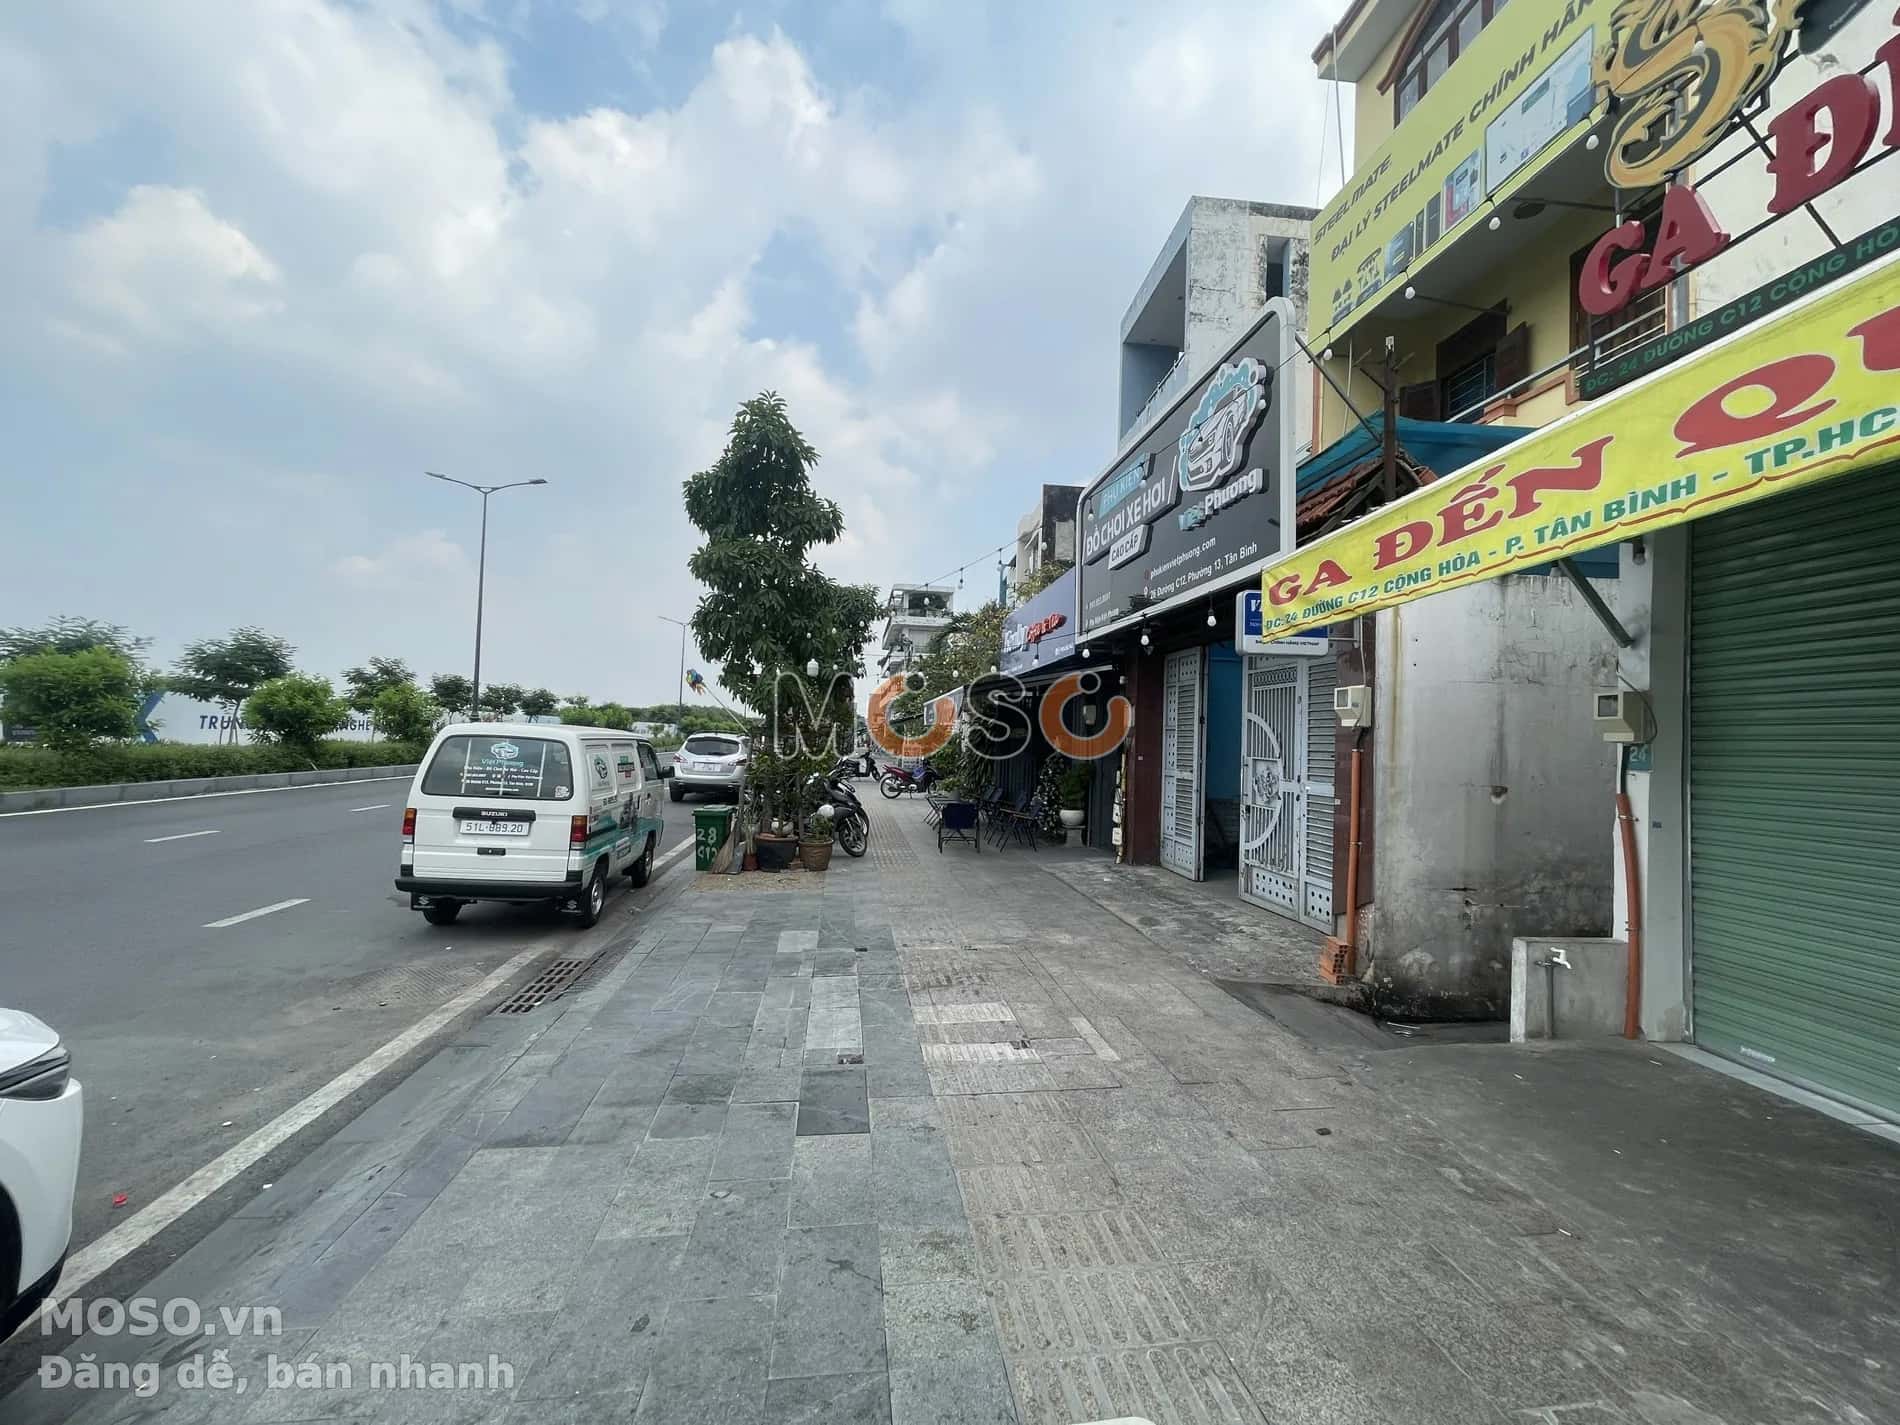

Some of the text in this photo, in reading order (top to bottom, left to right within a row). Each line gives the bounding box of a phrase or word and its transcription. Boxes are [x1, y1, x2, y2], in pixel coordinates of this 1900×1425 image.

[1373, 117, 1466, 222] STEELMATE
[1469, 43, 1536, 122] CHÍNH
[1314, 154, 1392, 246] STEELMATE
[1579, 184, 1731, 316] GA
[1720, 295, 1761, 325] C12
[1127, 496, 1142, 529] XE
[1224, 552, 1238, 567] Tân
[1240, 541, 1258, 560] Bình
[1269, 558, 1352, 606] GA
[1373, 434, 1614, 571] ĐẾN
[1348, 585, 1378, 604] C12
[1384, 567, 1431, 594] CỘNG
[1439, 550, 1481, 577] HÒA
[1505, 536, 1525, 556] P.
[1534, 510, 1593, 545] TÂN
[1602, 474, 1697, 522] BÌNH
